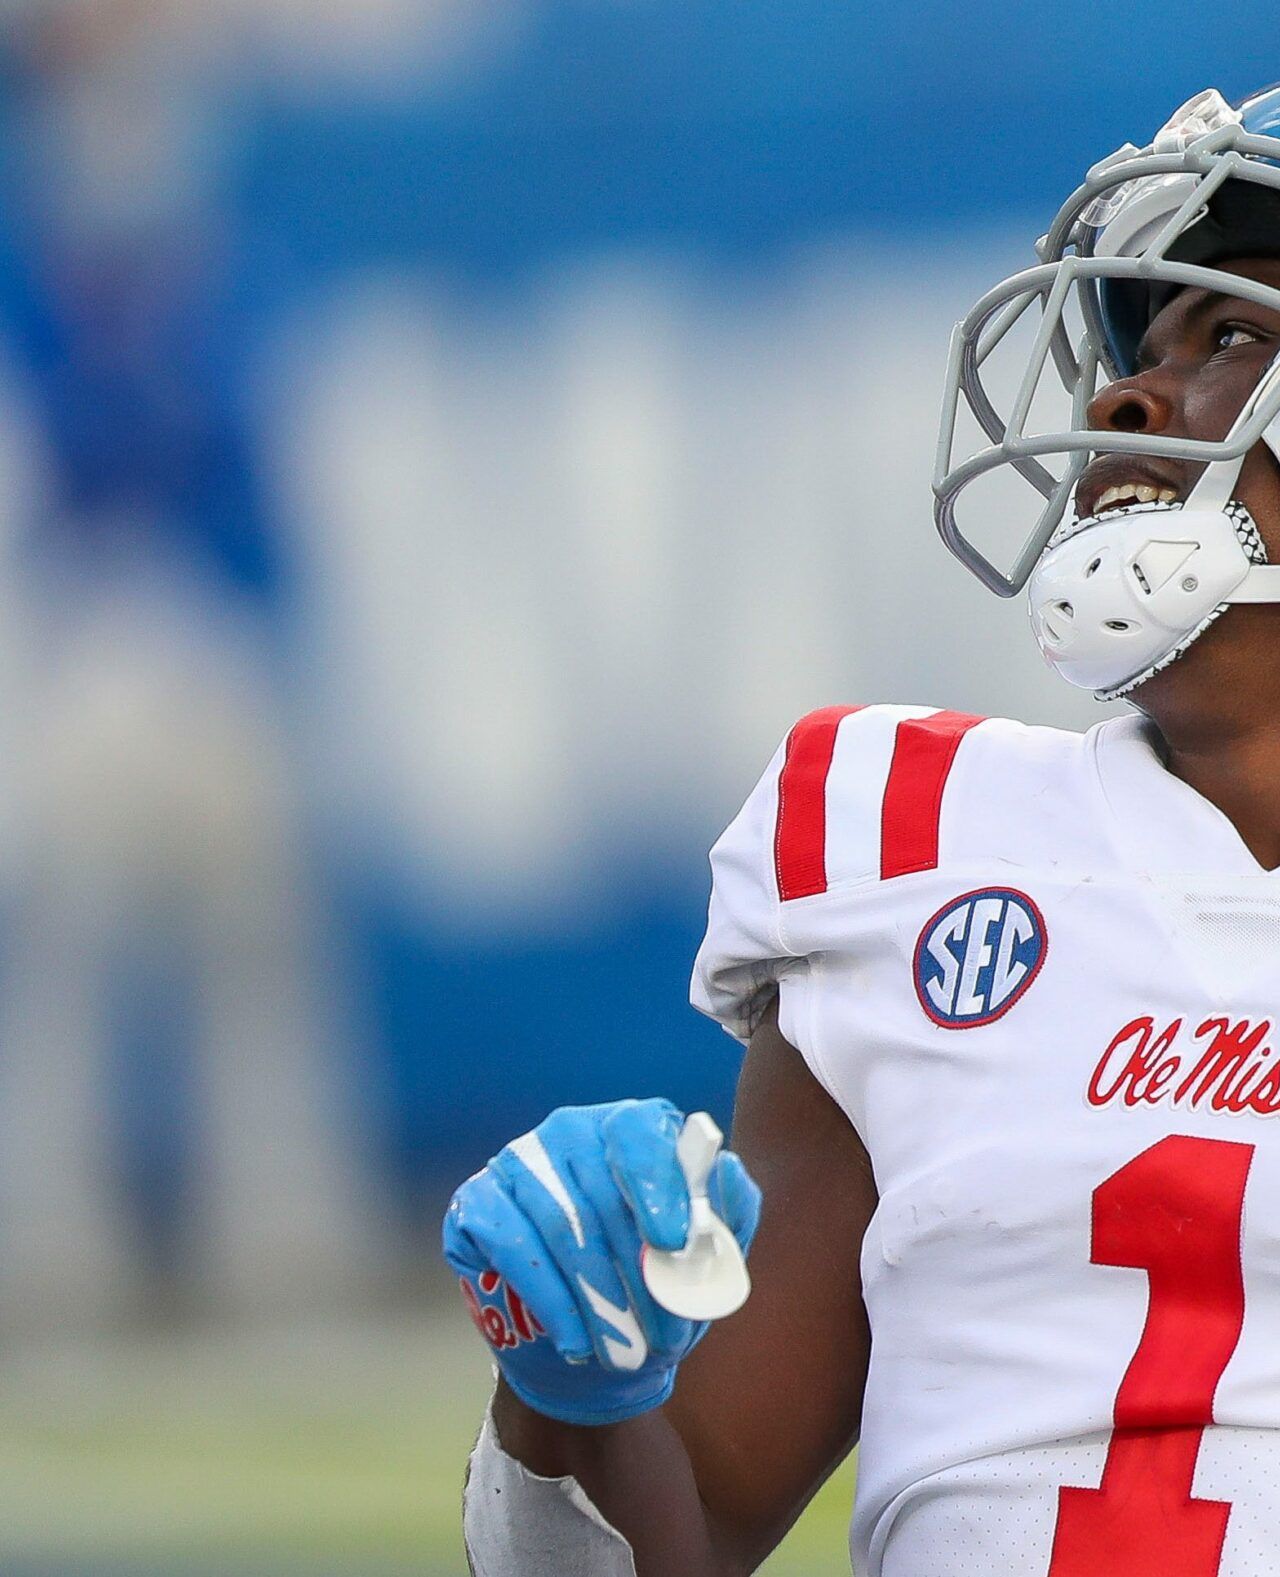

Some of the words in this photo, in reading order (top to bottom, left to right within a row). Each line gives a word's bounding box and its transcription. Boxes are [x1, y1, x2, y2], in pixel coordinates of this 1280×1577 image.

[925, 898, 1035, 1016] SEC
[1087, 1015, 1182, 1107] Ole
[1048, 1134, 1255, 1577] 1
